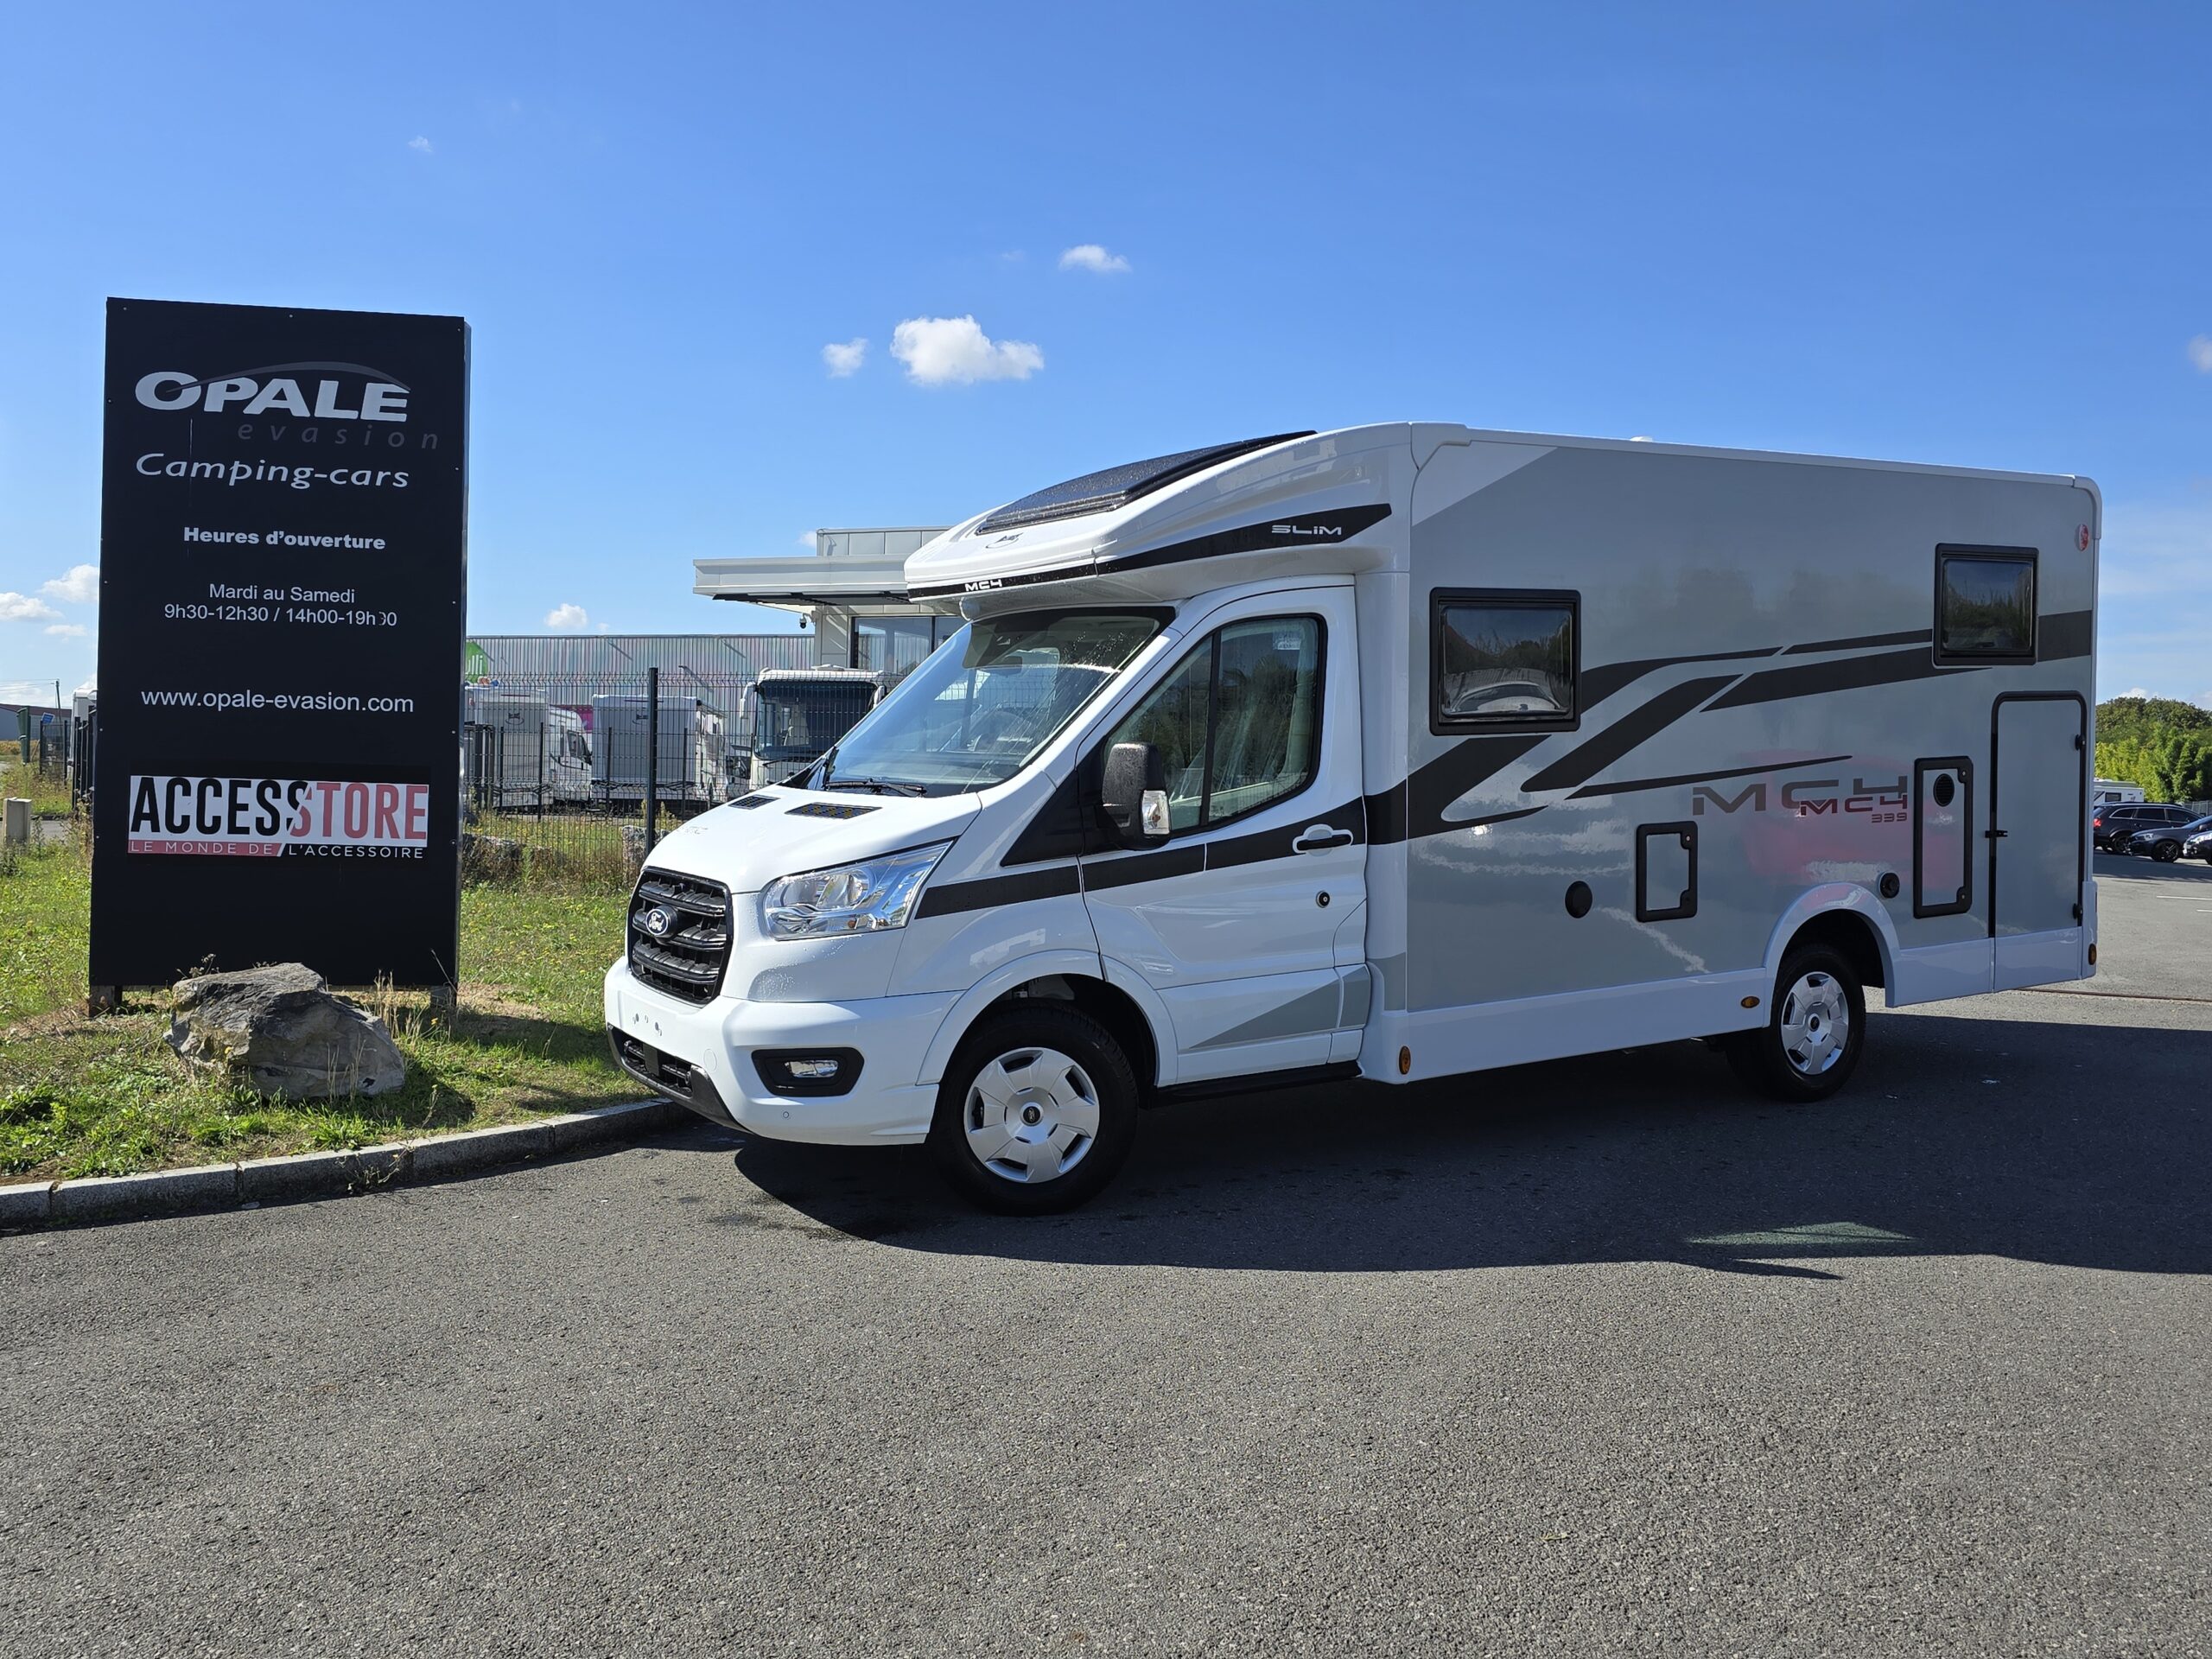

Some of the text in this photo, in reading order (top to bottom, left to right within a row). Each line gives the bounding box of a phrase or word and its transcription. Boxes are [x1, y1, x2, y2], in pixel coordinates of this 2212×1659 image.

[135, 371, 410, 422] OPALE
[238, 423, 438, 449] evasion
[135, 453, 410, 490] Camping-cars
[183, 527, 385, 550] Heures d'ouverture
[209, 583, 355, 603] Mardi au Samedi
[964, 579, 1002, 591] MC4
[164, 604, 269, 621] 9h30-12h30
[141, 690, 414, 712] www.opale-evasion.com
[1693, 775, 1908, 816] MC4
[1800, 794, 1908, 816] MC4
[130, 777, 428, 839] ACCESSTORE
[130, 840, 424, 859] LE MONDE DE L'ACCESSOIRE
